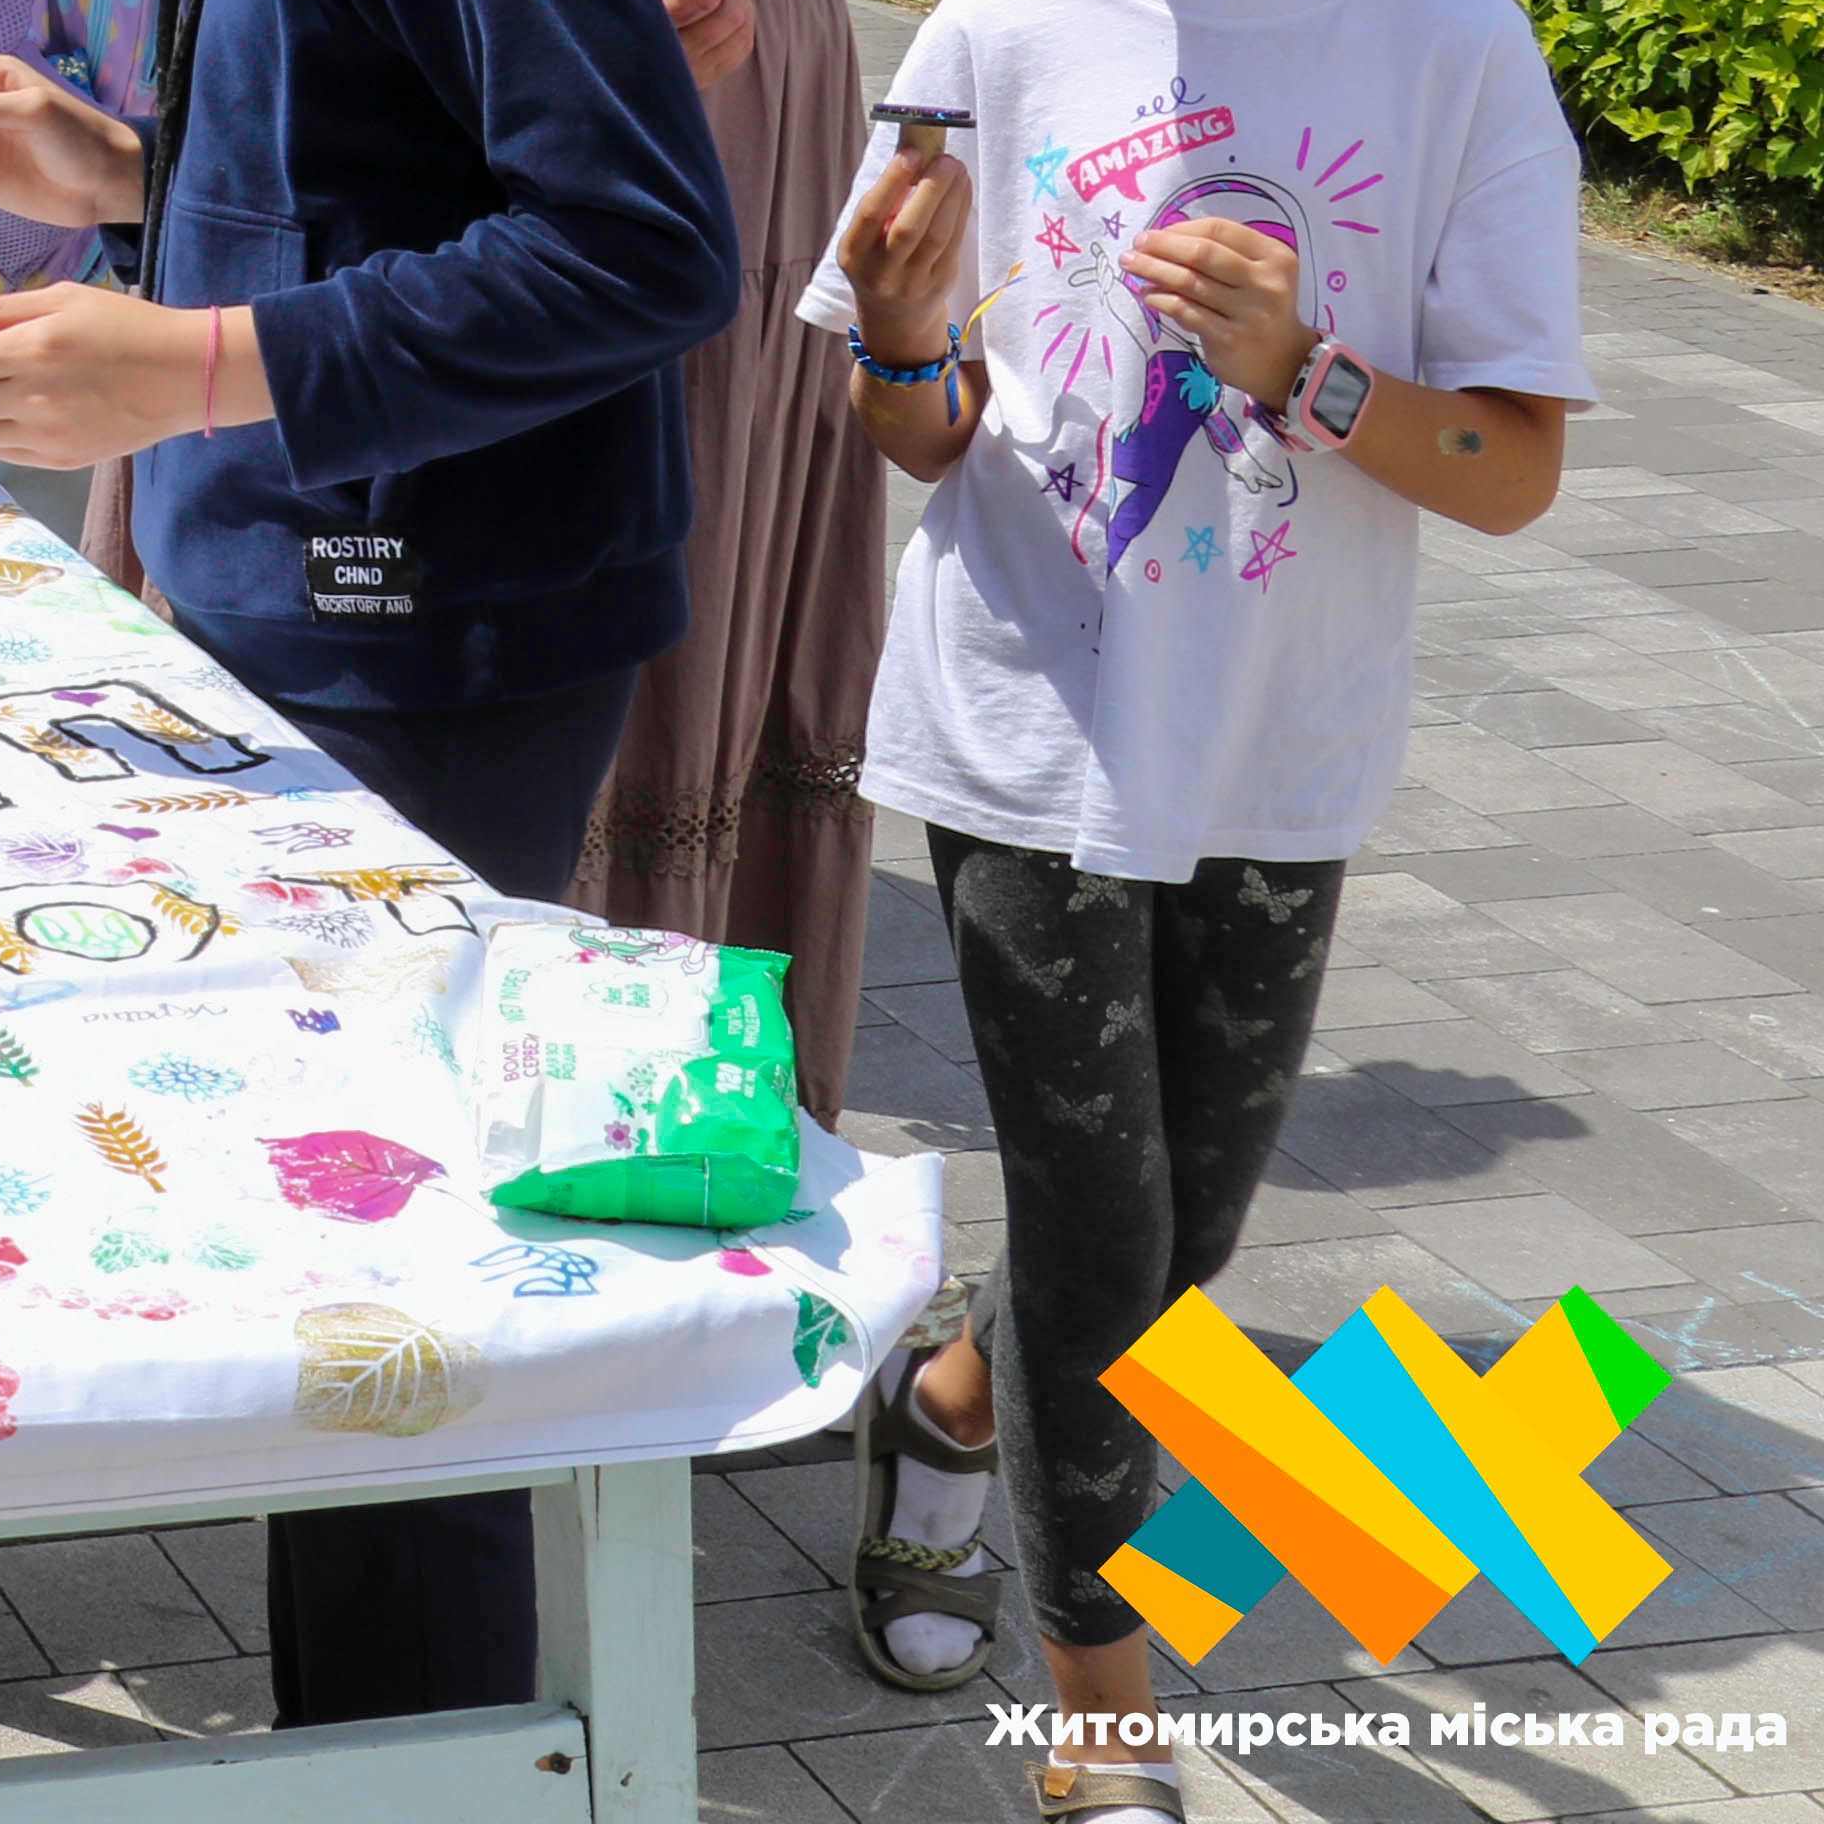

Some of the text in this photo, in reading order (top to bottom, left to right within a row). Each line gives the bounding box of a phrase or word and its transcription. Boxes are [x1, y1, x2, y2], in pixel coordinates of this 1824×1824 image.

[1078, 114, 1227, 191] AMAZING
[311, 536, 405, 560] ROSTIRY
[333, 565, 384, 586] CHND
[314, 596, 414, 615] ROCKSTORY AND
